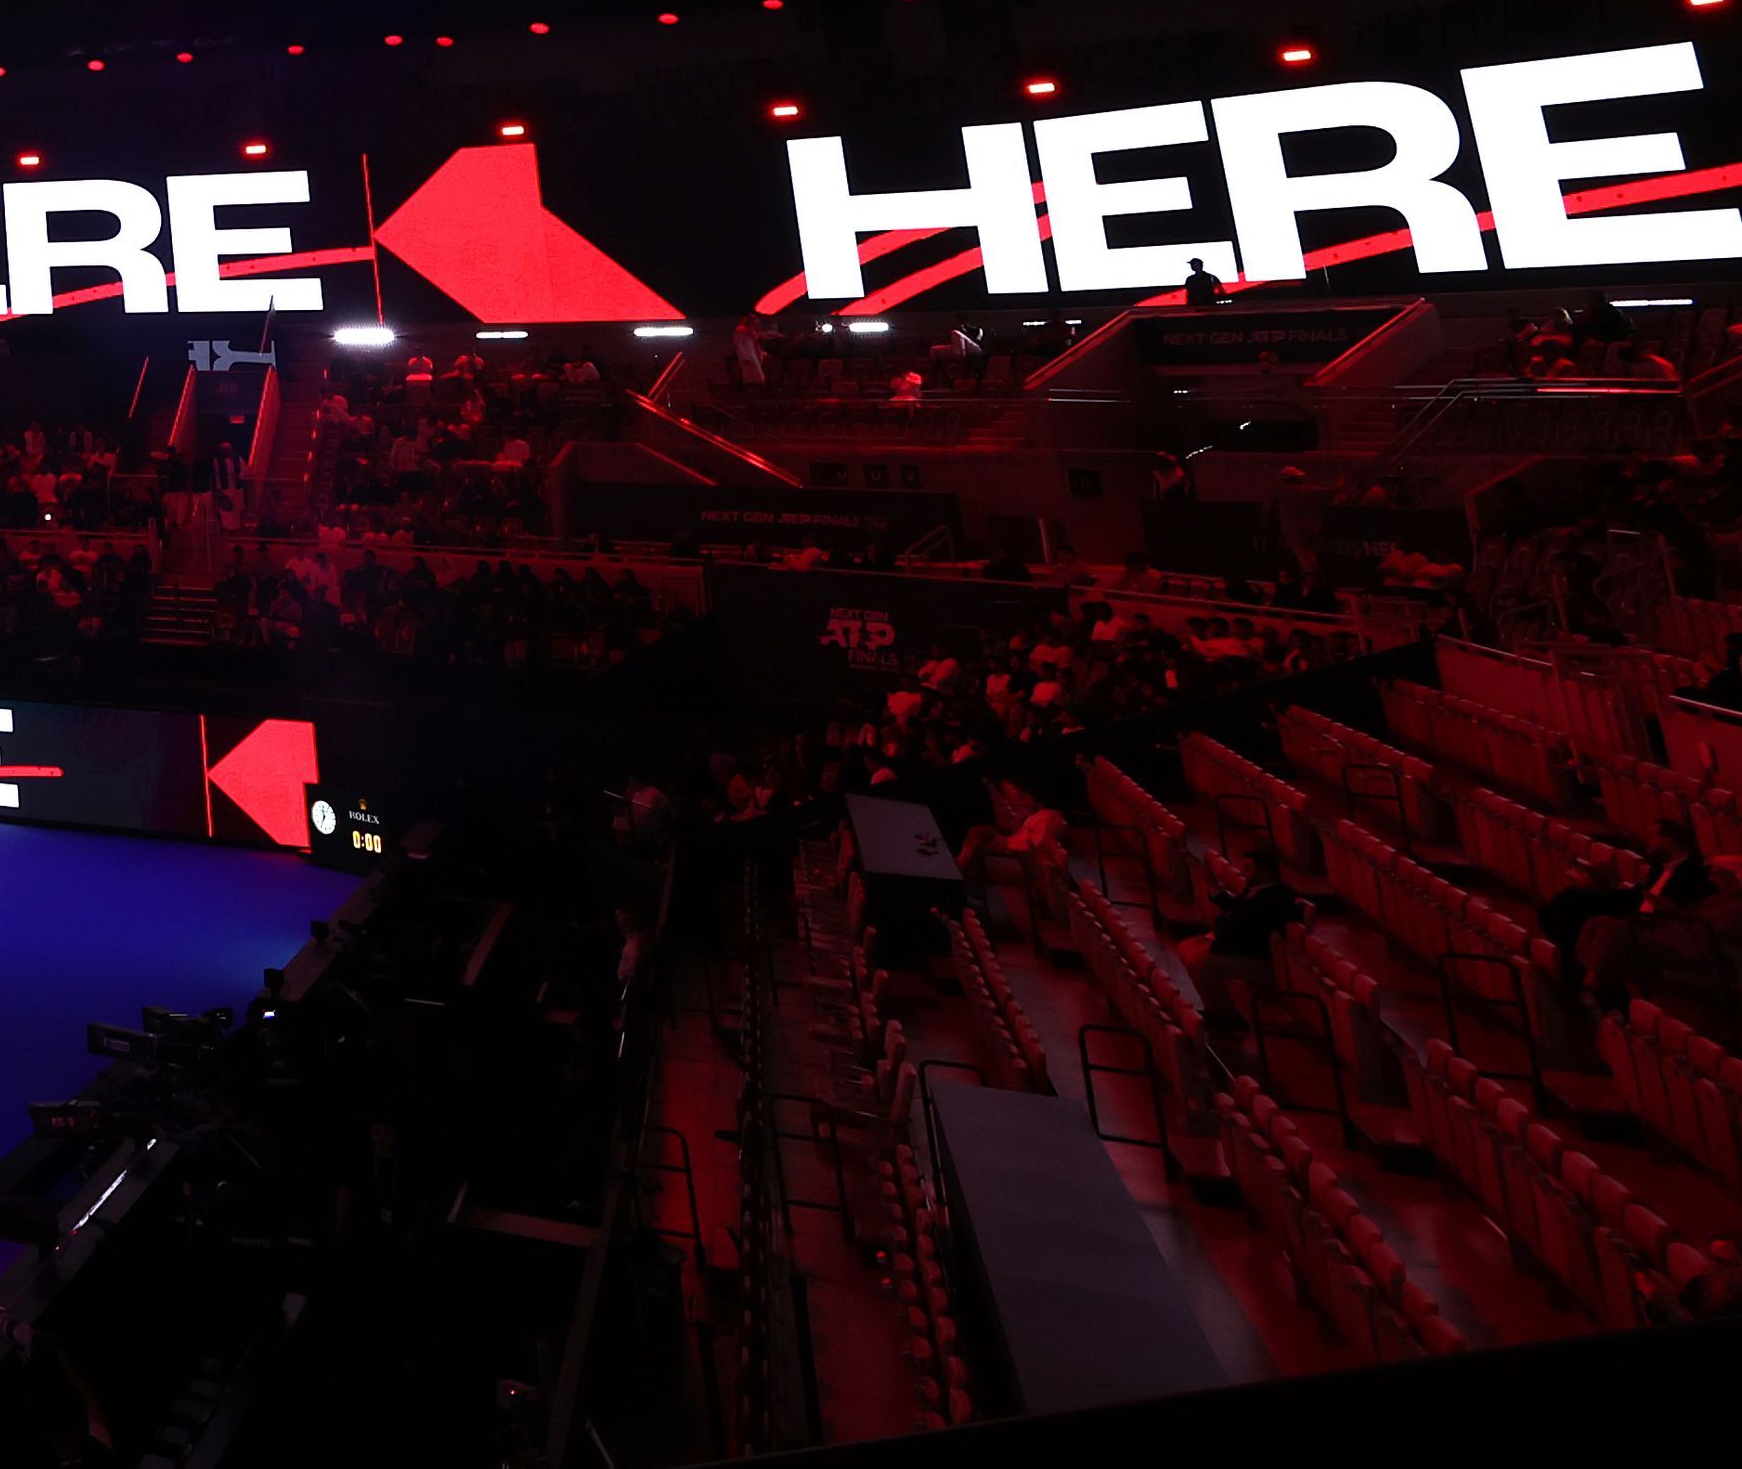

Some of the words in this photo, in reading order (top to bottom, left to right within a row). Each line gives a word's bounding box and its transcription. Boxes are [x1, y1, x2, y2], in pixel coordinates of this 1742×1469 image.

[785, 40, 1742, 300] HERE
[819, 618, 897, 650] ATP
[348, 809, 380, 825] ROLEX
[352, 830, 382, 854] 0:00
